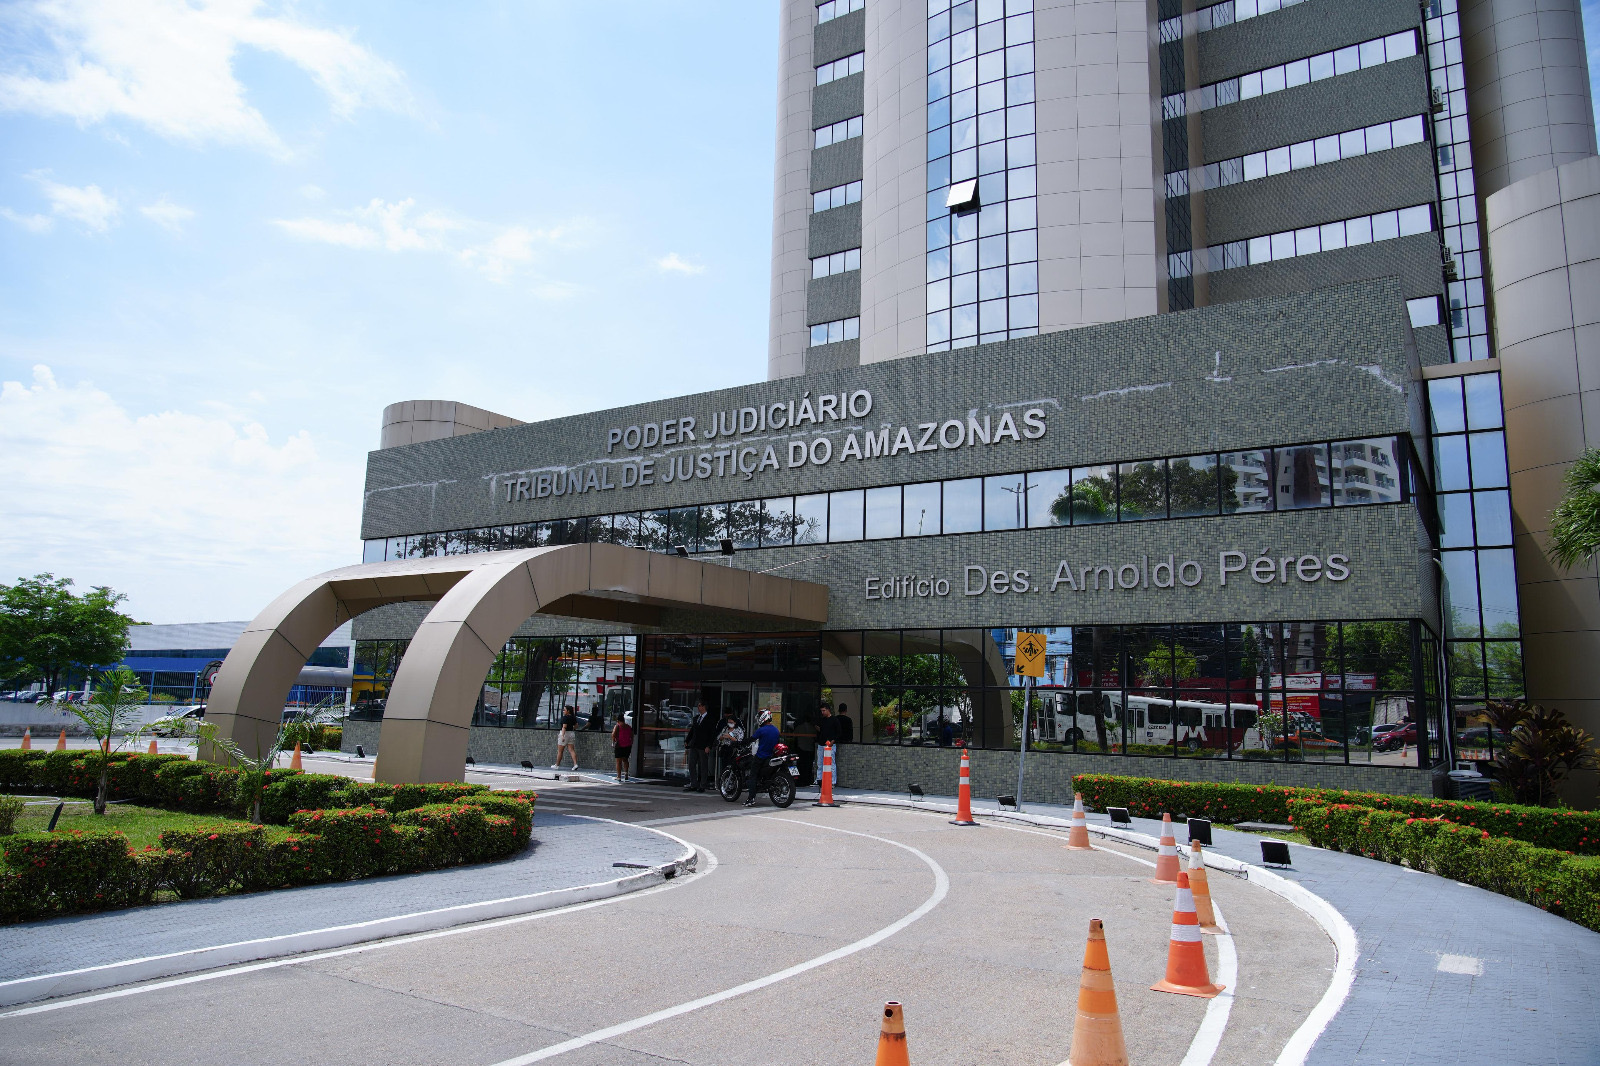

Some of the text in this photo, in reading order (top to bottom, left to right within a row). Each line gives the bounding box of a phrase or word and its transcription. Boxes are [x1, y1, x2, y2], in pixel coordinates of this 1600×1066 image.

[607, 389, 872, 452] PODER JUDICIÁRIO
[505, 408, 1046, 501] TRIBUNAL DE JUSTIÇA DO AMAZONAS
[864, 548, 1351, 600] Edifício Des. Arnoldo Péres
